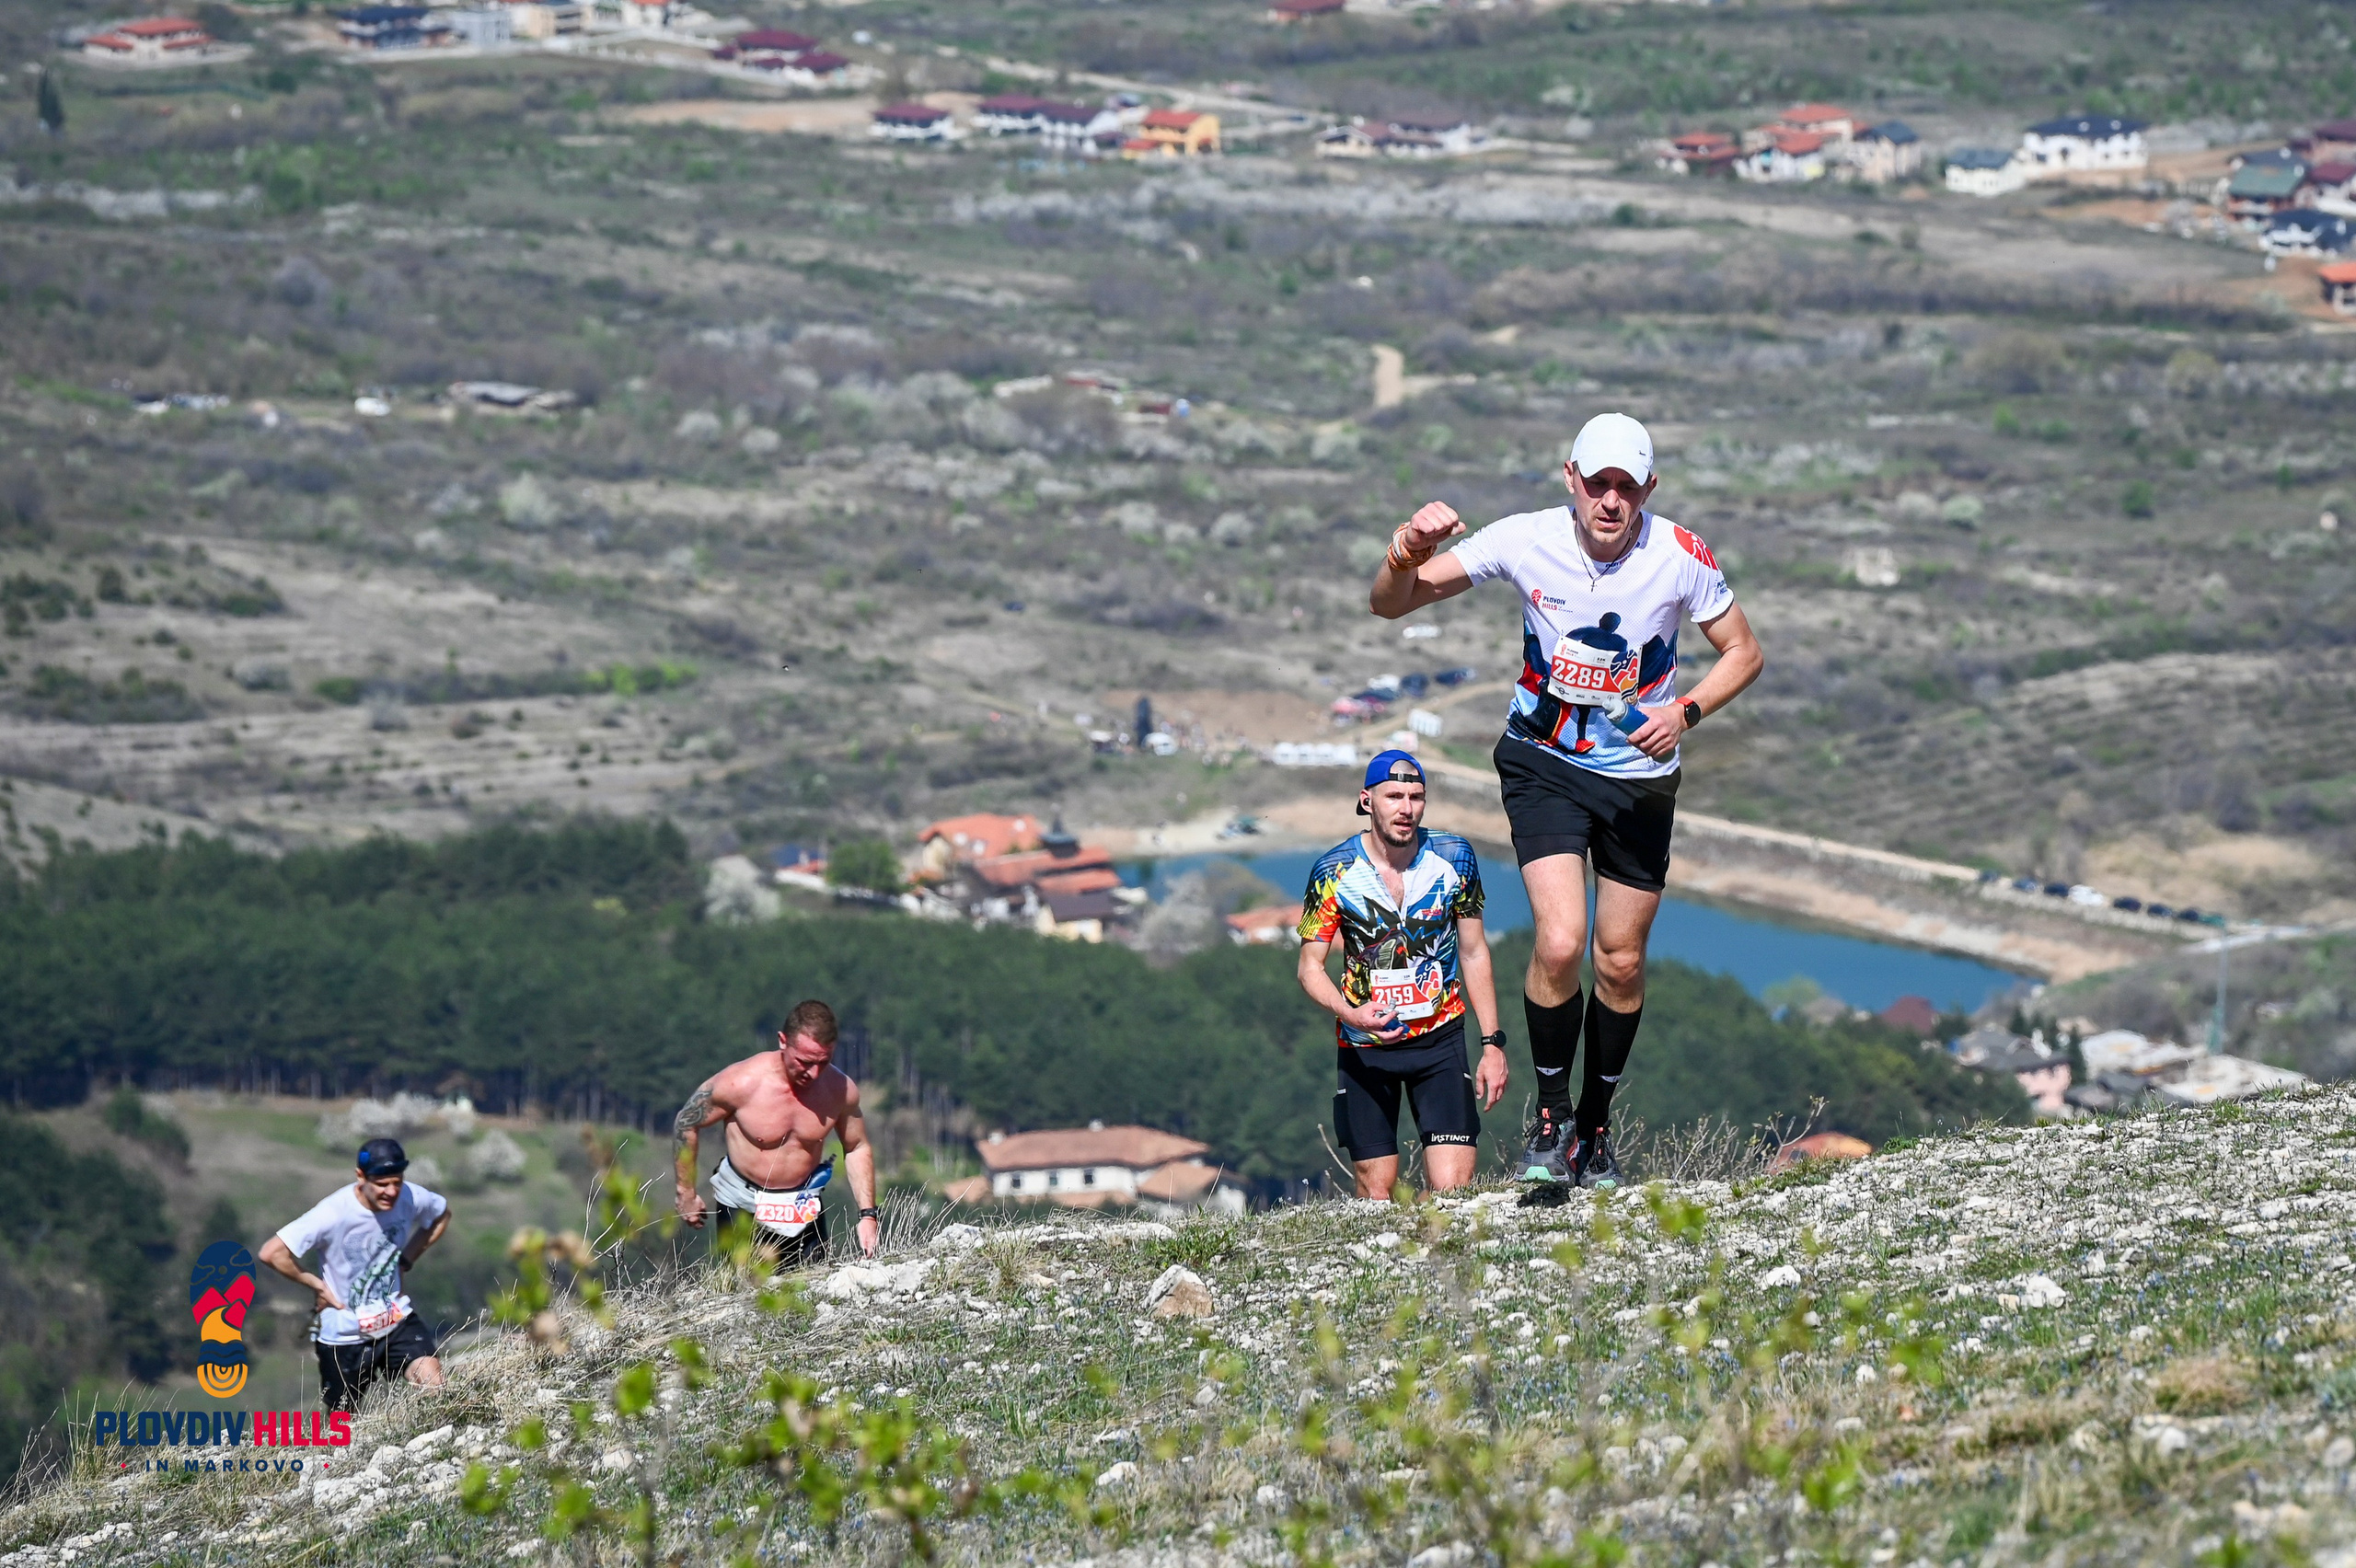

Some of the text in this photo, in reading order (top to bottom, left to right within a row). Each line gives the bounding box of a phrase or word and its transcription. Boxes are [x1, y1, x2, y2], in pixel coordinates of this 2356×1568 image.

[1542, 595, 1566, 605] PLOVDIV
[1542, 603, 1558, 611] HILLS
[1552, 659, 1607, 689] 2289
[1374, 986, 1415, 1006] 2159
[756, 1205, 795, 1222] 2320
